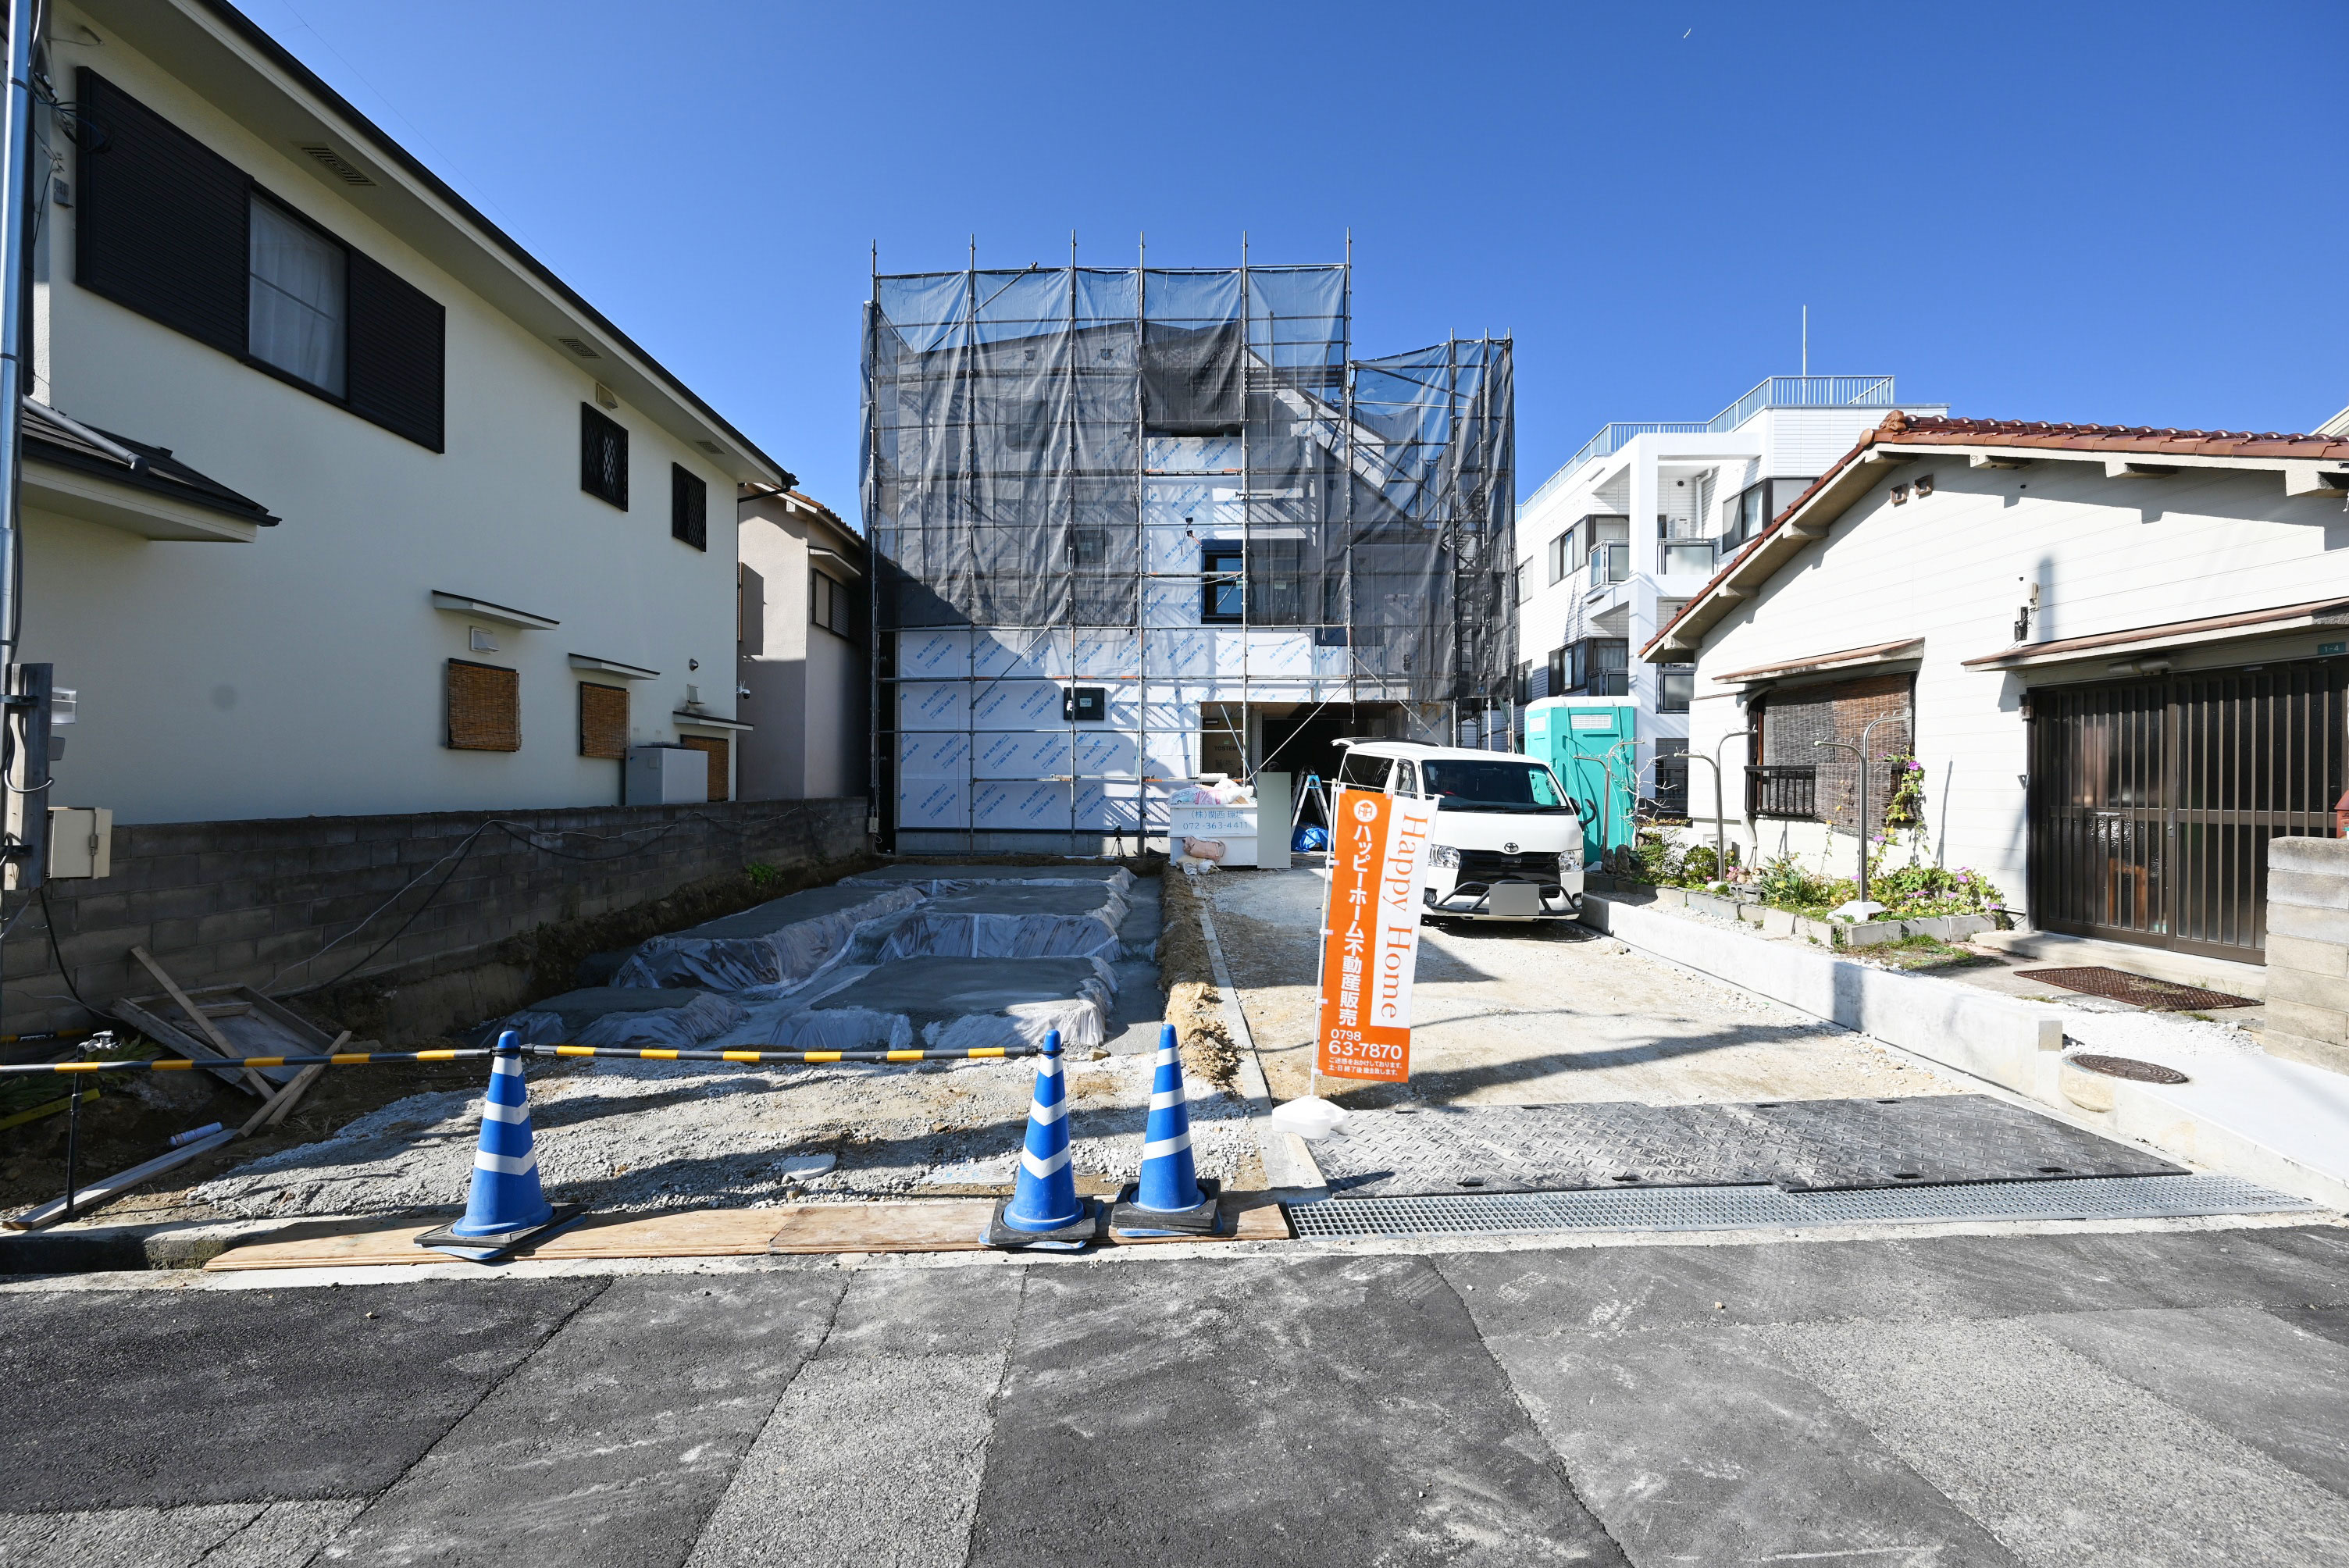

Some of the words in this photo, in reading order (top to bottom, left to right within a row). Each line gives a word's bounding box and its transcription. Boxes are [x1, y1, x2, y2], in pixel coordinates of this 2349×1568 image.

[1384, 814, 1428, 912] Happy
[1338, 824, 1371, 1026] ハッピーホーム不動産販売
[1381, 924, 1413, 1019] Home
[1328, 1039, 1403, 1060] 63-7870
[1331, 1029, 1361, 1041] 0798
